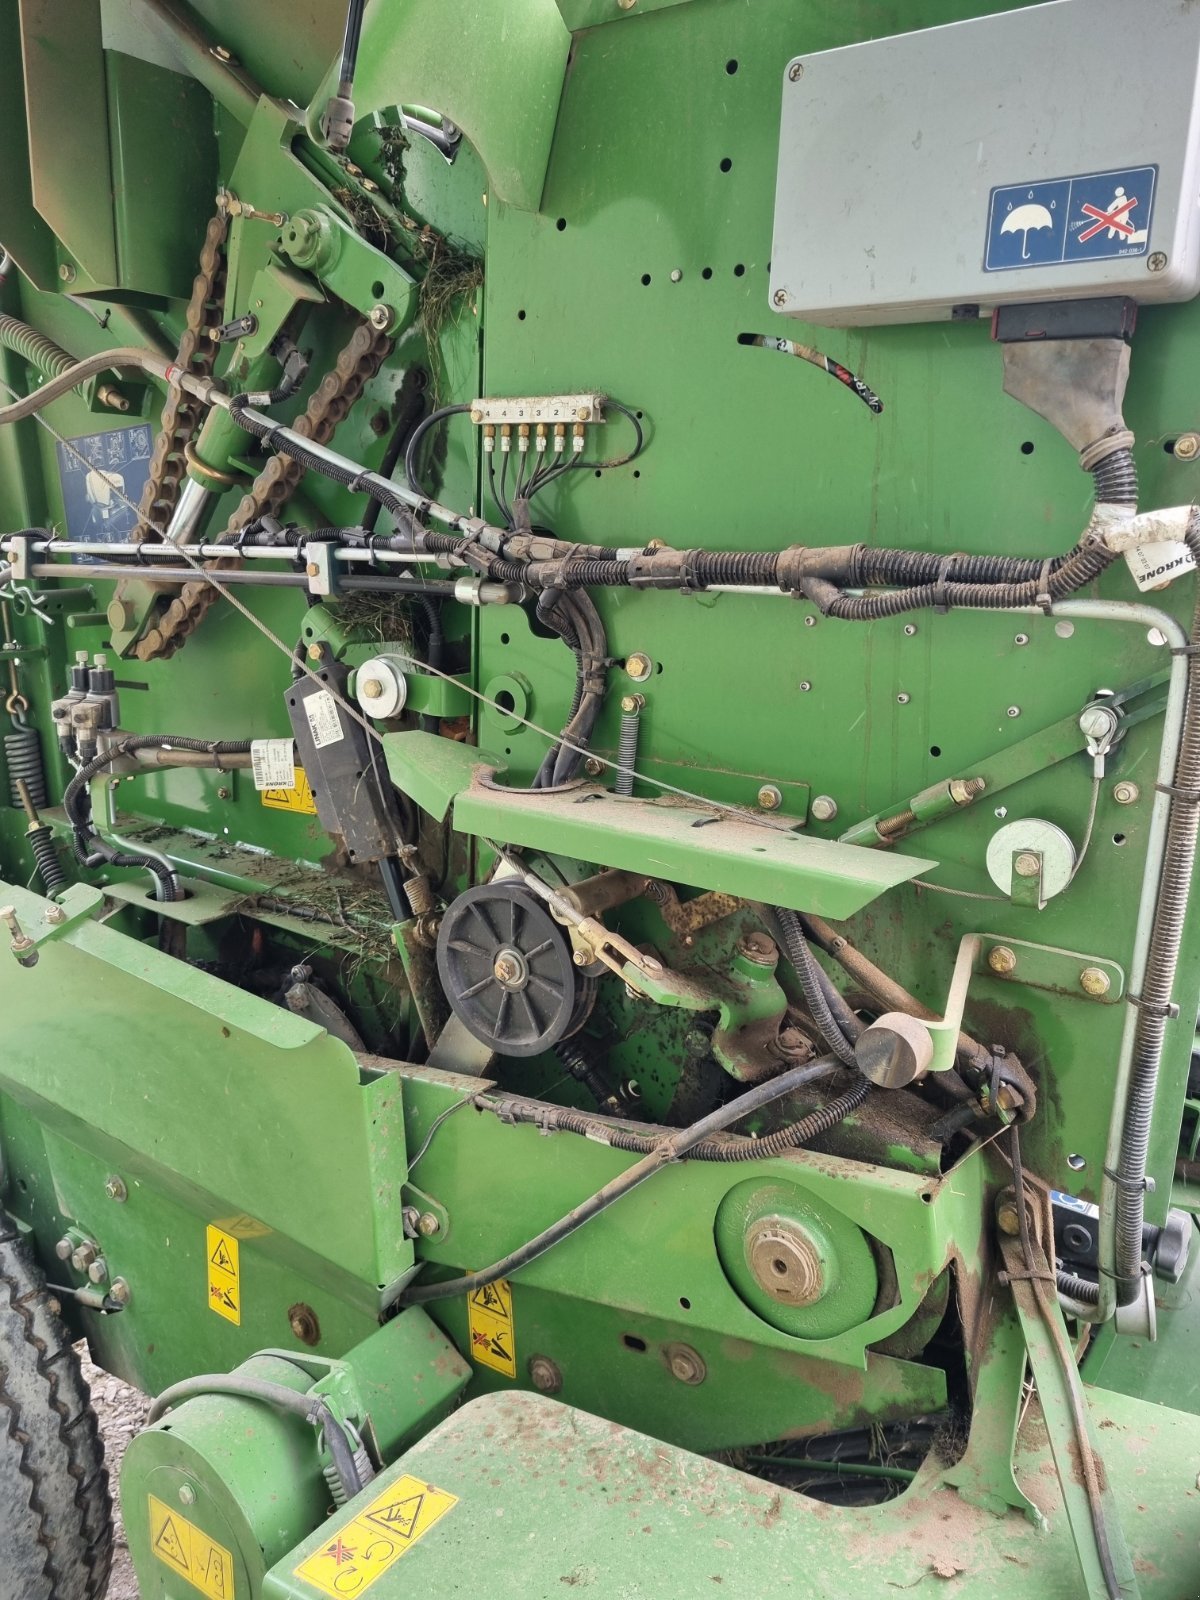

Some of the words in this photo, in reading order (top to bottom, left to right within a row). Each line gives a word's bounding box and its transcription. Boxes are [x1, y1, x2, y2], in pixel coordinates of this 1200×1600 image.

[571, 408, 577, 416] 2
[1139, 556, 1183, 584] KRONE
[311, 723, 321, 746] LINAK
